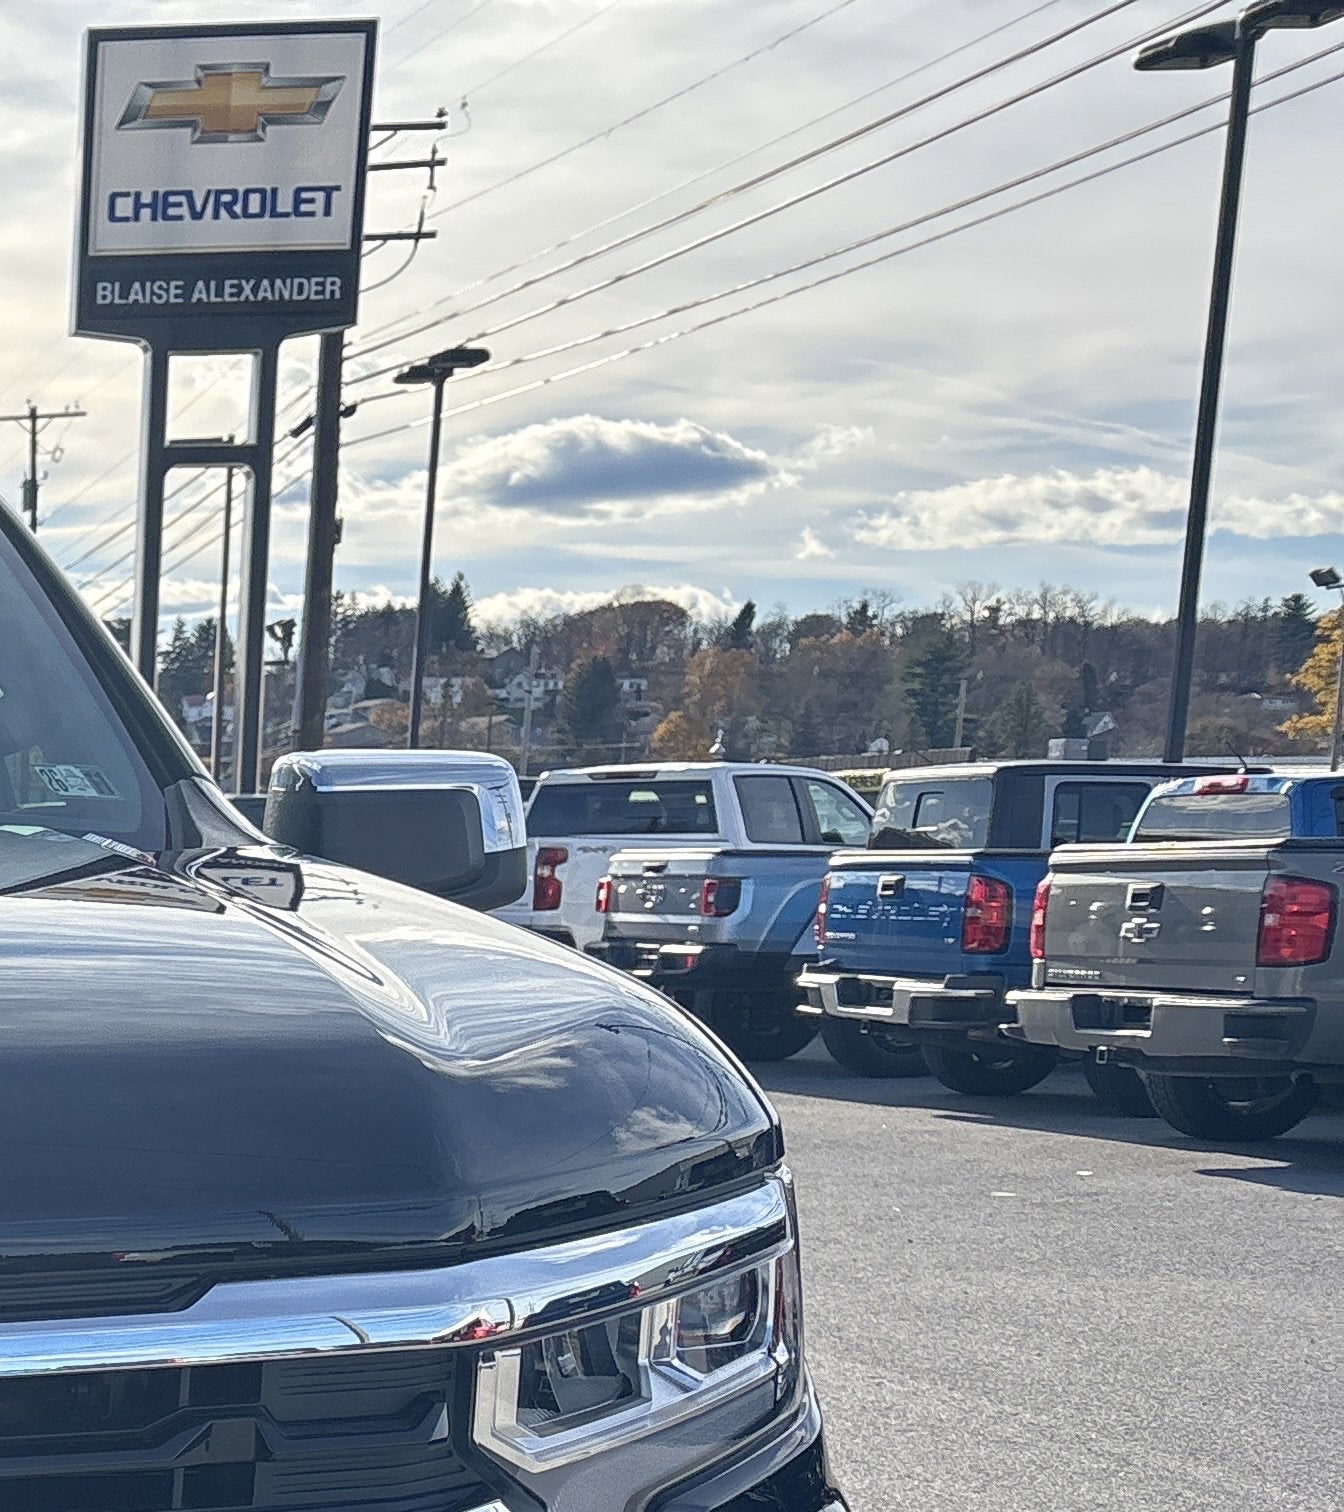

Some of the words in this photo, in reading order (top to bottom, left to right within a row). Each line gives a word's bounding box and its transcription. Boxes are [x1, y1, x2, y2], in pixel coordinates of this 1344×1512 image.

[108, 185, 342, 223] CHEVROLET
[96, 280, 184, 305] BLAISE
[191, 276, 342, 302] ALEXANDER
[39, 768, 70, 793] 26
